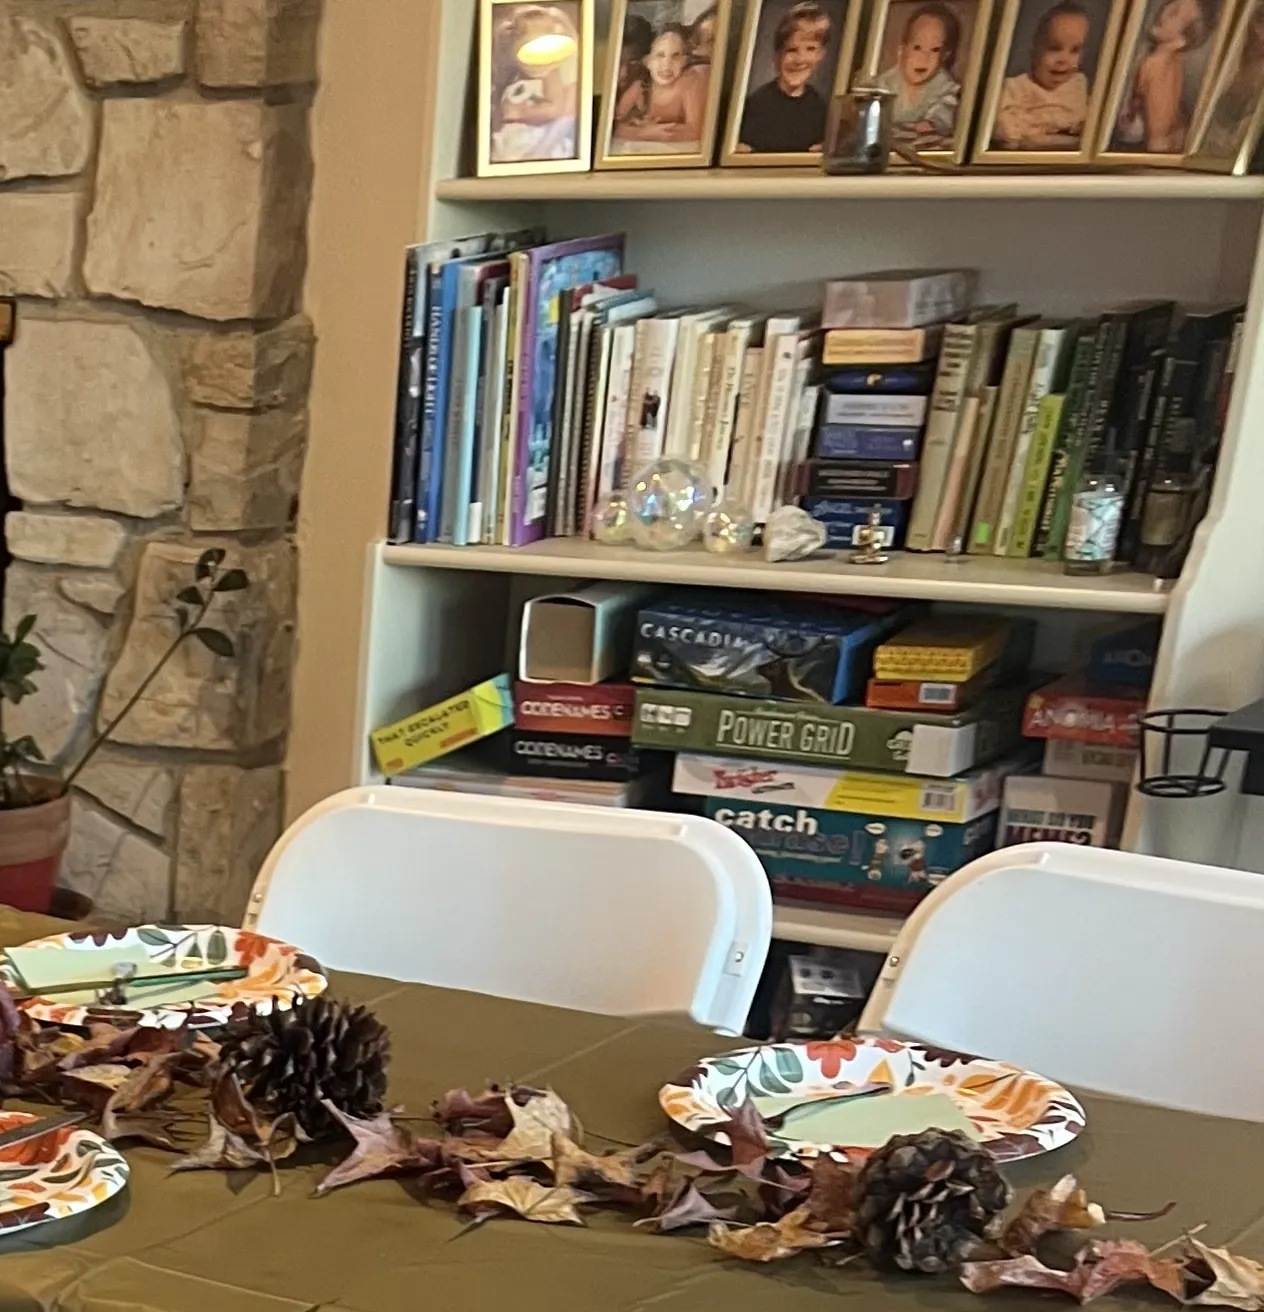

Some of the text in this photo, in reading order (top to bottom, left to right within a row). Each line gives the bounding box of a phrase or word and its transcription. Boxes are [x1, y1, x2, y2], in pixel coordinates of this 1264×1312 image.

[521, 701, 612, 719] CODENAMES
[717, 710, 793, 749] POWER
[800, 720, 855, 755] GRID
[515, 741, 603, 760] CODENAMES
[715, 808, 818, 835] catch
